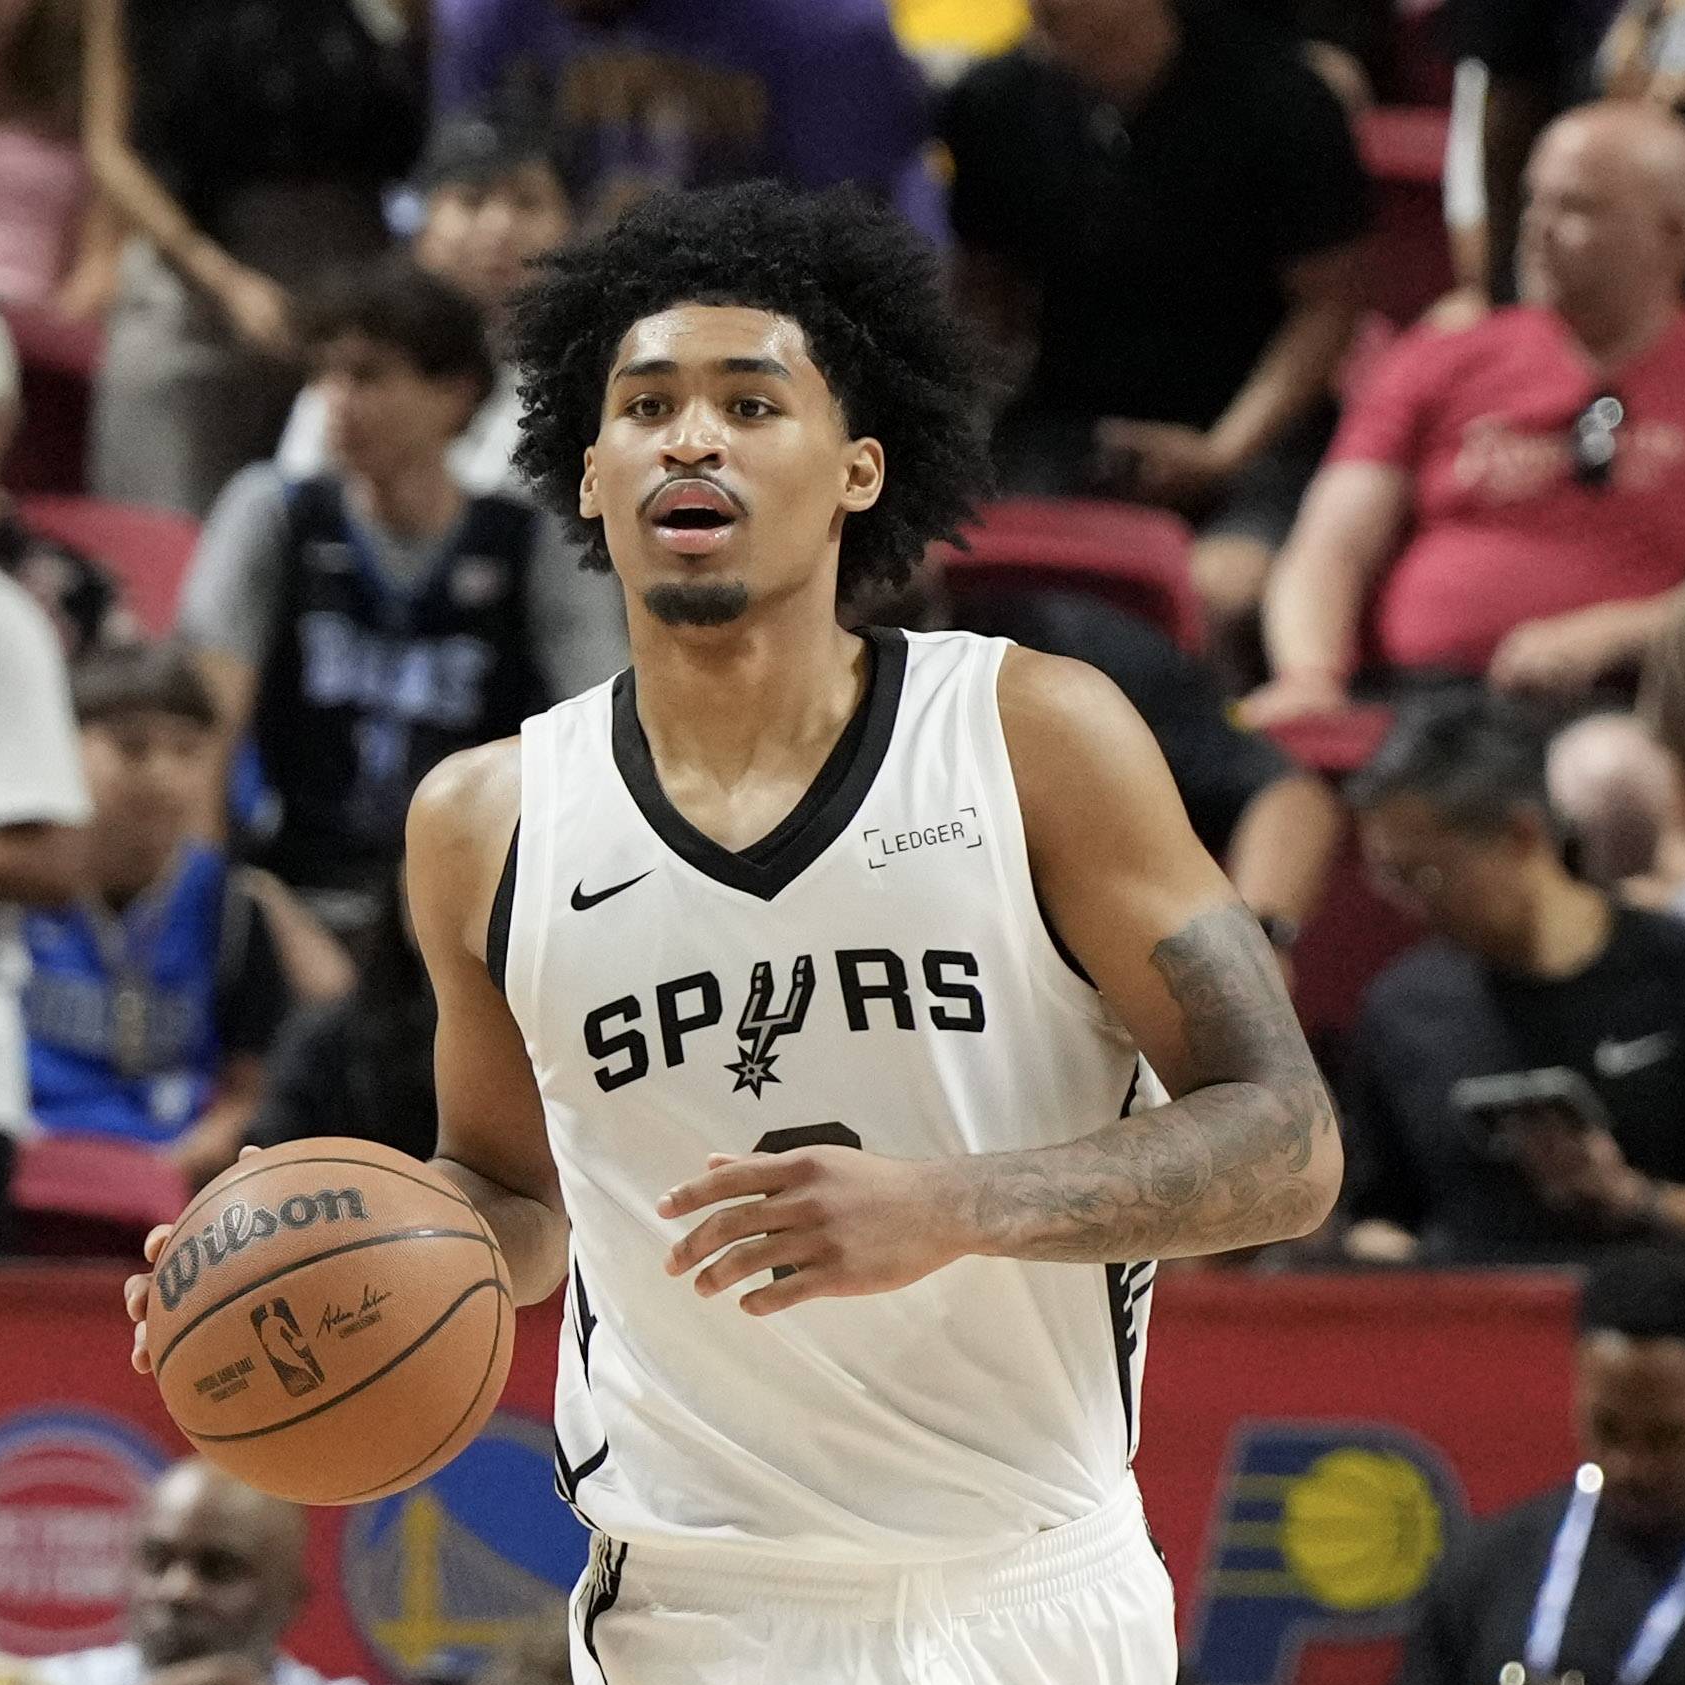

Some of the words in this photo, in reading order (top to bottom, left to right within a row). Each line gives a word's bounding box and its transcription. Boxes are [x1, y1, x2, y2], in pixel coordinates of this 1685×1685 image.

[881, 821, 965, 855] LEDGER
[583, 949, 987, 1100] SPURS
[156, 1187, 371, 1312] Wilson
